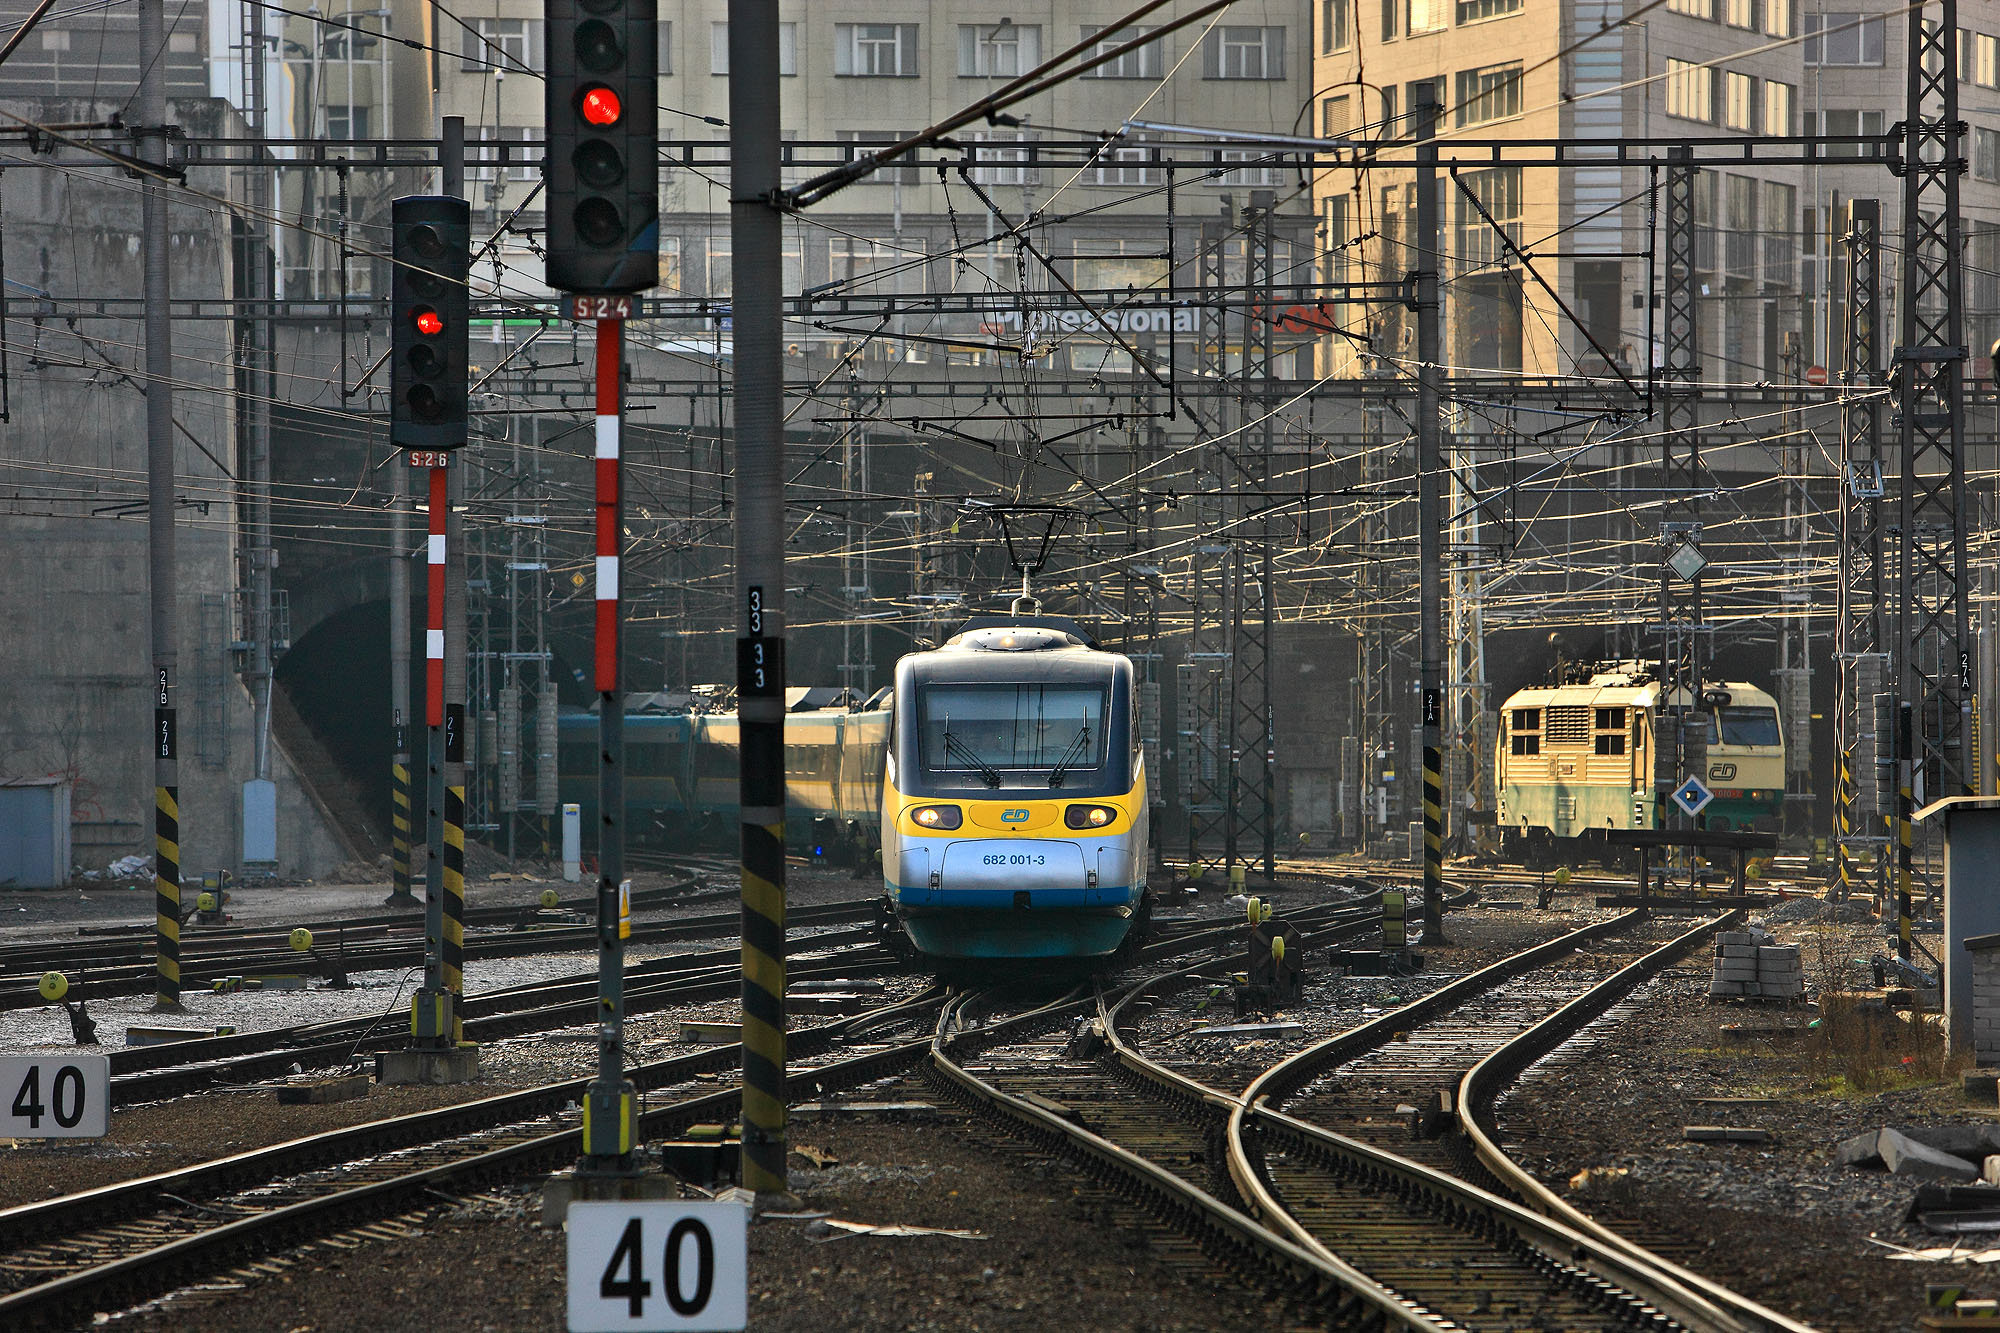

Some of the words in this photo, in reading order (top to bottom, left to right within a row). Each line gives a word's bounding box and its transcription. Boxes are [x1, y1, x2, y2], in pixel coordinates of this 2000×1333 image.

[577, 297, 629, 318] S24
[411, 452, 447, 467] S26
[1961, 653, 1970, 688] 27A
[447, 716, 454, 746] 27
[983, 854, 1007, 866] 682
[1009, 854, 1045, 866] 001-3
[11, 1065, 86, 1129] 40
[599, 1216, 715, 1319] 40
